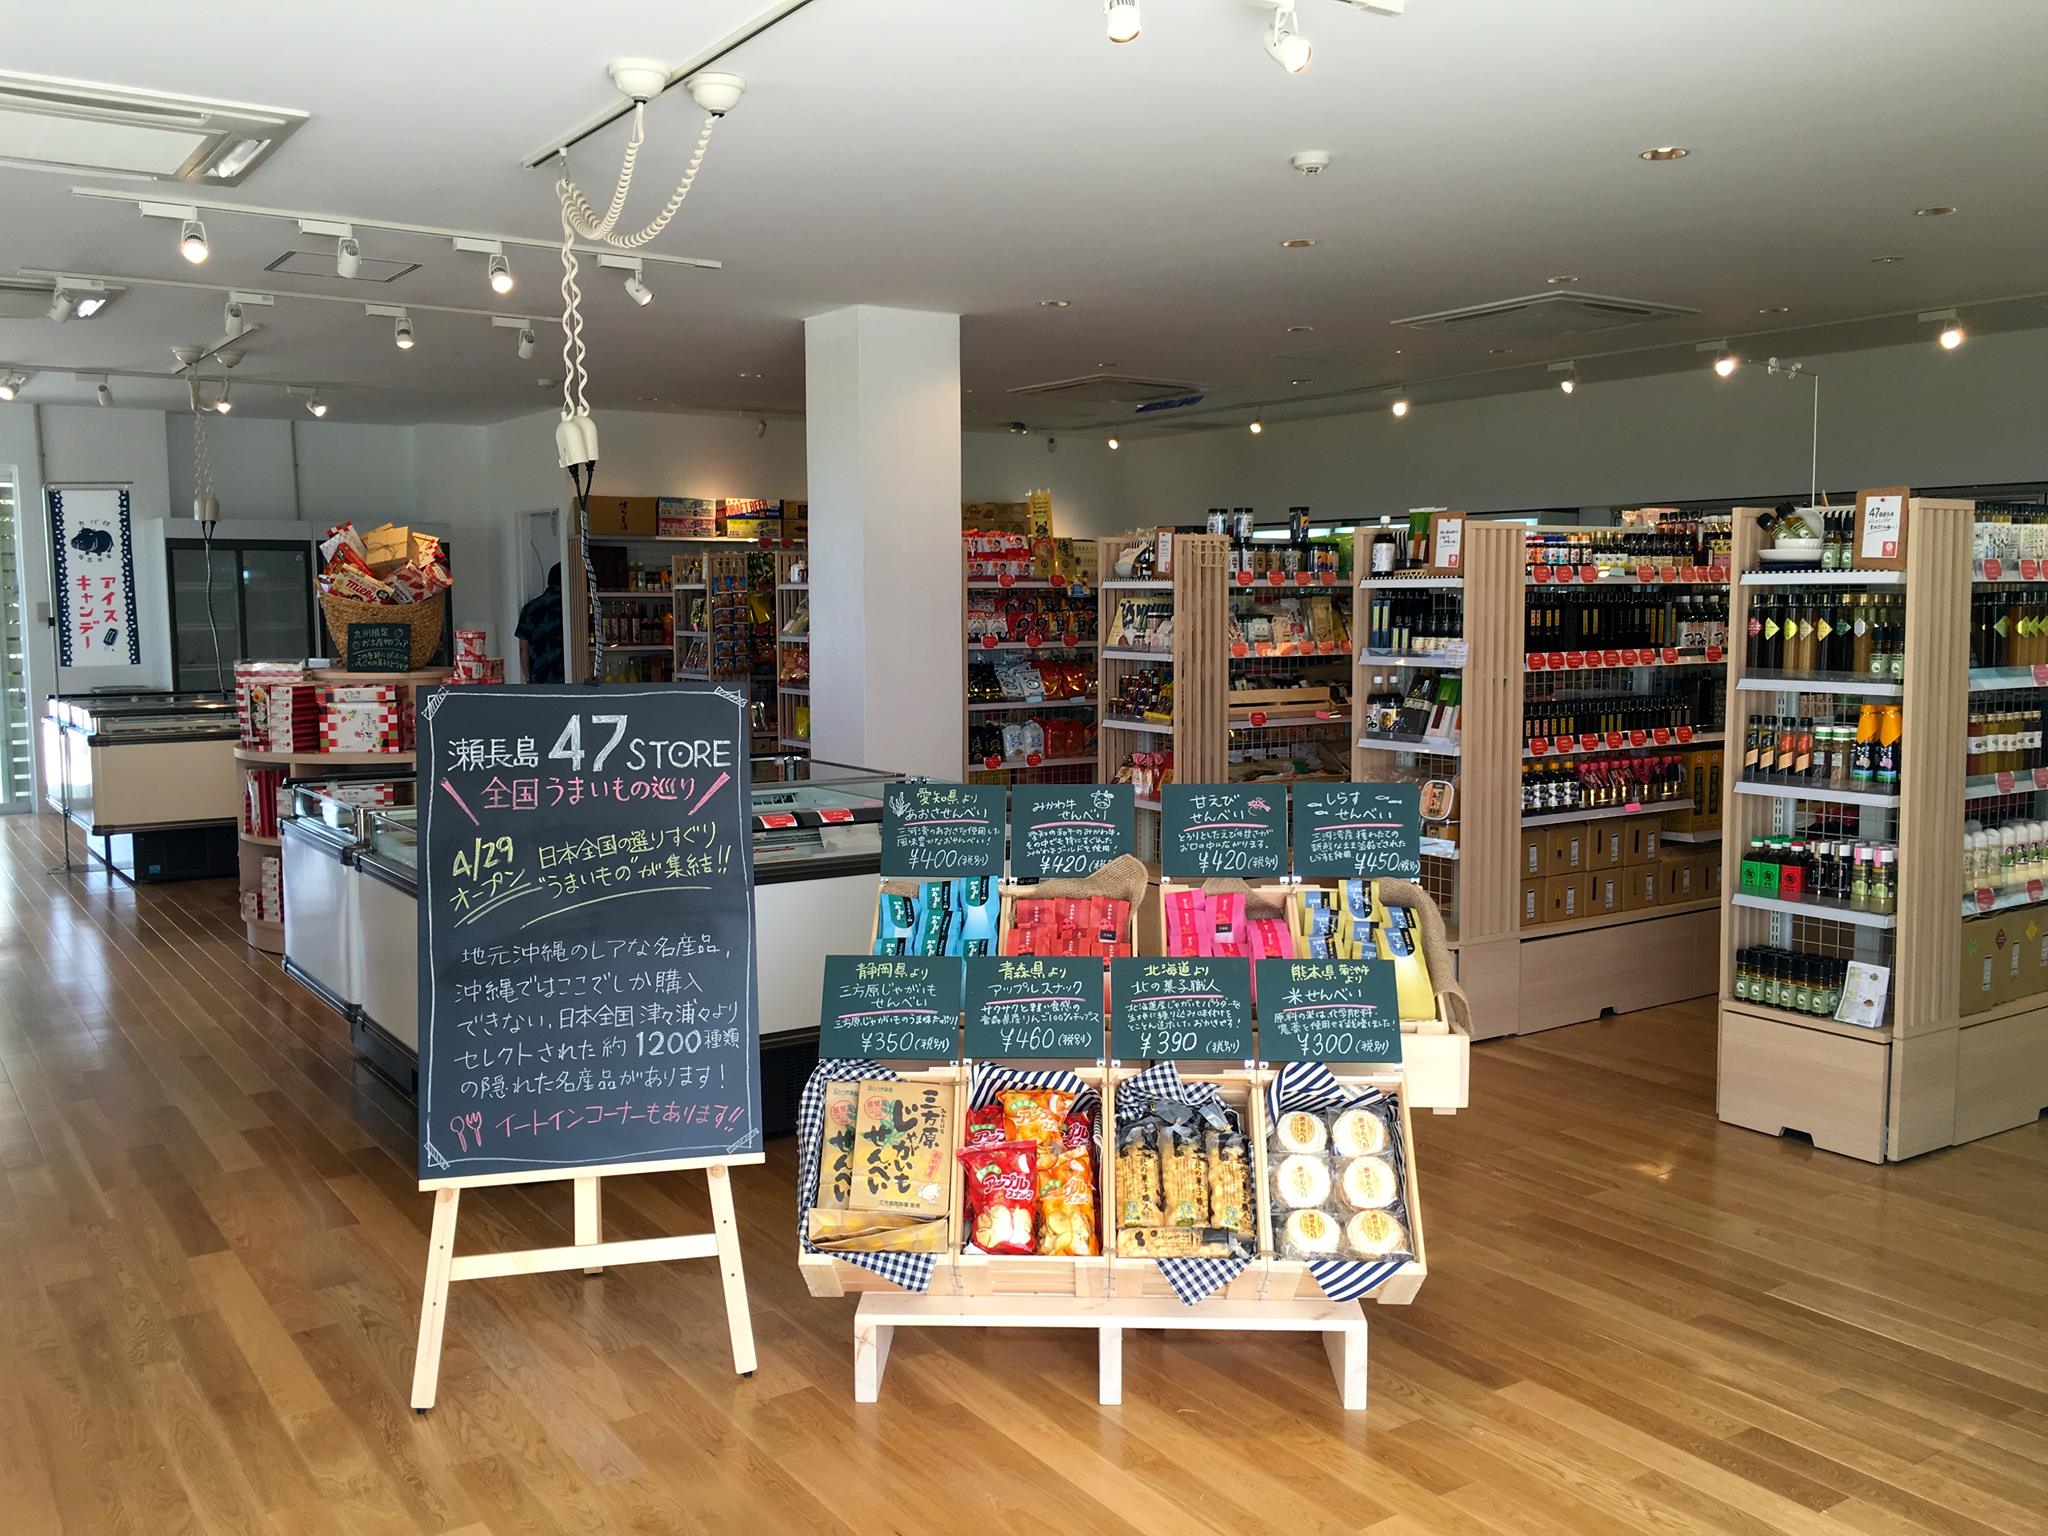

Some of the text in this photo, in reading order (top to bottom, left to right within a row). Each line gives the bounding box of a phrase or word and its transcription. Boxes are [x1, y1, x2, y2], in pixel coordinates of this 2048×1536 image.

[101, 577, 118, 623] アイス
[76, 575, 100, 649] キャンデー
[447, 714, 732, 772] 瀬長島 47 STORE
[481, 776, 697, 810] 全国うまいもの巡り
[917, 787, 978, 806] 愛知県より
[1189, 794, 1240, 809] 甘えび
[1326, 792, 1360, 805] しらす
[905, 807, 987, 821] あおさせんべい
[1032, 799, 1076, 812] みかわ牛
[1335, 808, 1392, 820] せんべい
[1058, 809, 1107, 821] せんべい
[1190, 809, 1244, 823] せんべい
[539, 821, 717, 869] 日本全国の選りすぐり
[452, 836, 514, 880] 4/29
[450, 868, 525, 911] オープン
[856, 962, 929, 980] 静岡県より
[998, 961, 1067, 980] 青森県より
[1144, 961, 1209, 977] 北海道より
[1291, 963, 1337, 981] 熊本県
[455, 968, 703, 1004] 沖縄ではここでしか購入
[1131, 978, 1221, 995] 北の菓子職人
[1345, 975, 1362, 984] より
[840, 982, 937, 998] 三方原じゃがいも
[1282, 987, 1361, 1005] 米せんべい
[871, 996, 927, 1008] せんべい
[920, 1089, 940, 1149] 三方原
[892, 1099, 919, 1193] じゃがいも
[863, 1124, 892, 1195] せんべい
[983, 1172, 1030, 1195] アップル
[1005, 1189, 1033, 1200] スナック
